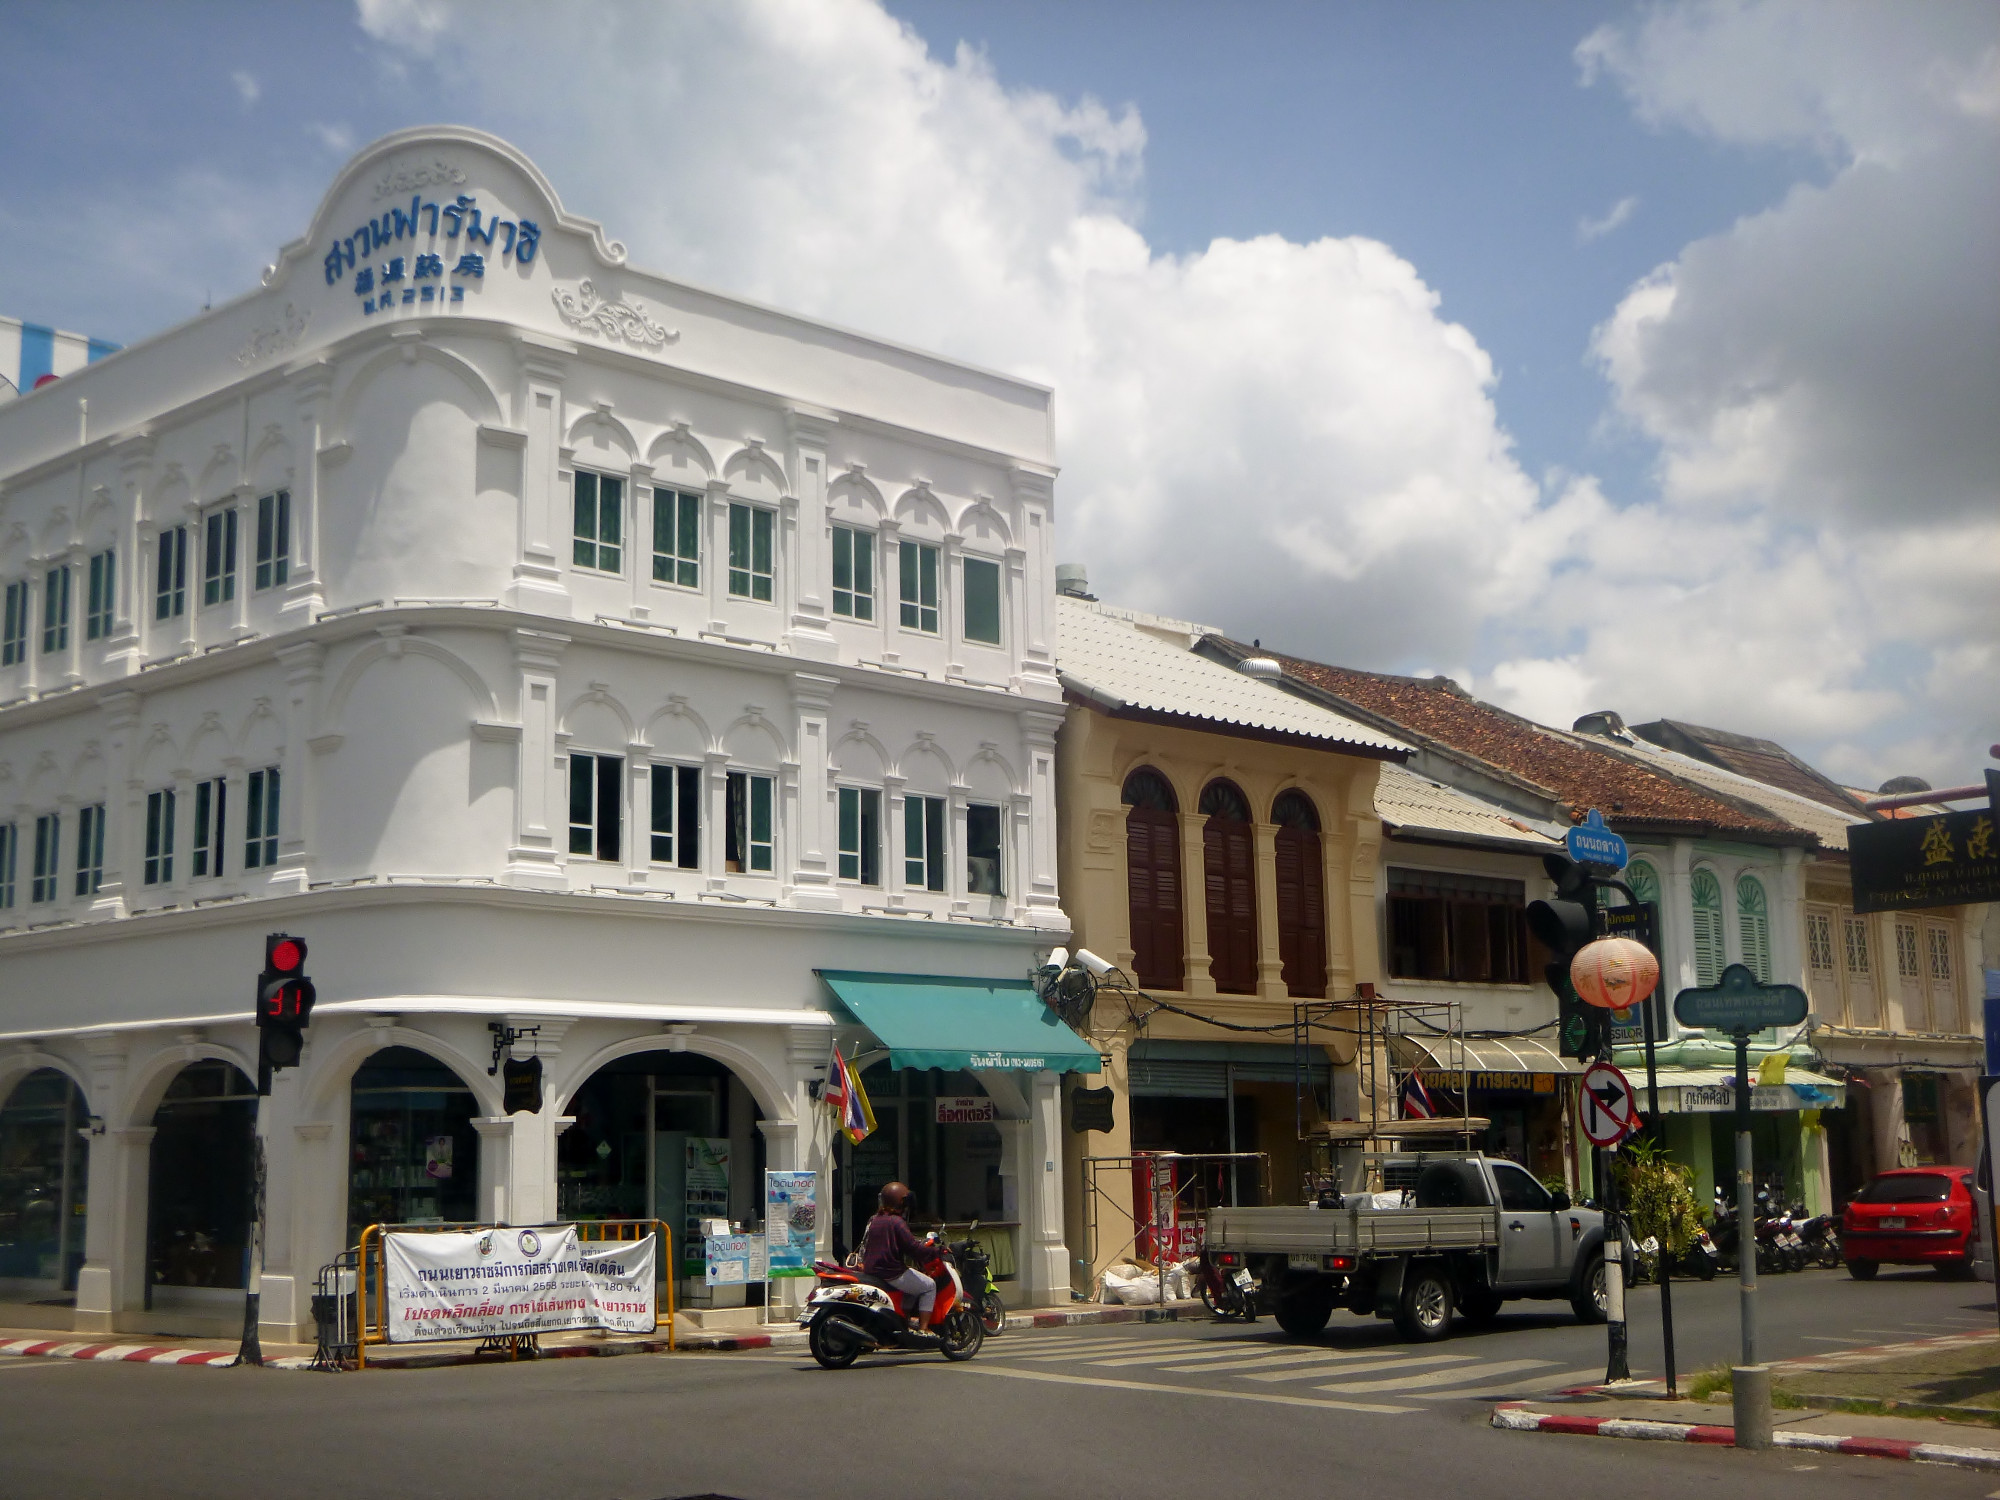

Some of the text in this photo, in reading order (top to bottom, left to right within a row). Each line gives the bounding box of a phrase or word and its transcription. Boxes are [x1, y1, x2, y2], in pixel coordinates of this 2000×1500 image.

[402, 286, 464, 304] 2513
[1576, 835, 1620, 855] ถนนถลาง
[1610, 1028, 1643, 1040] SSILOR
[482, 1286, 489, 1295] 2
[493, 1282, 529, 1294] มีนาคม
[533, 1281, 557, 1292] 2558
[604, 1282, 623, 1292] 180
[404, 1298, 504, 1321] โปรดหลีกเลี่ยง
[509, 1297, 586, 1314] การใช้เส้นทาง
